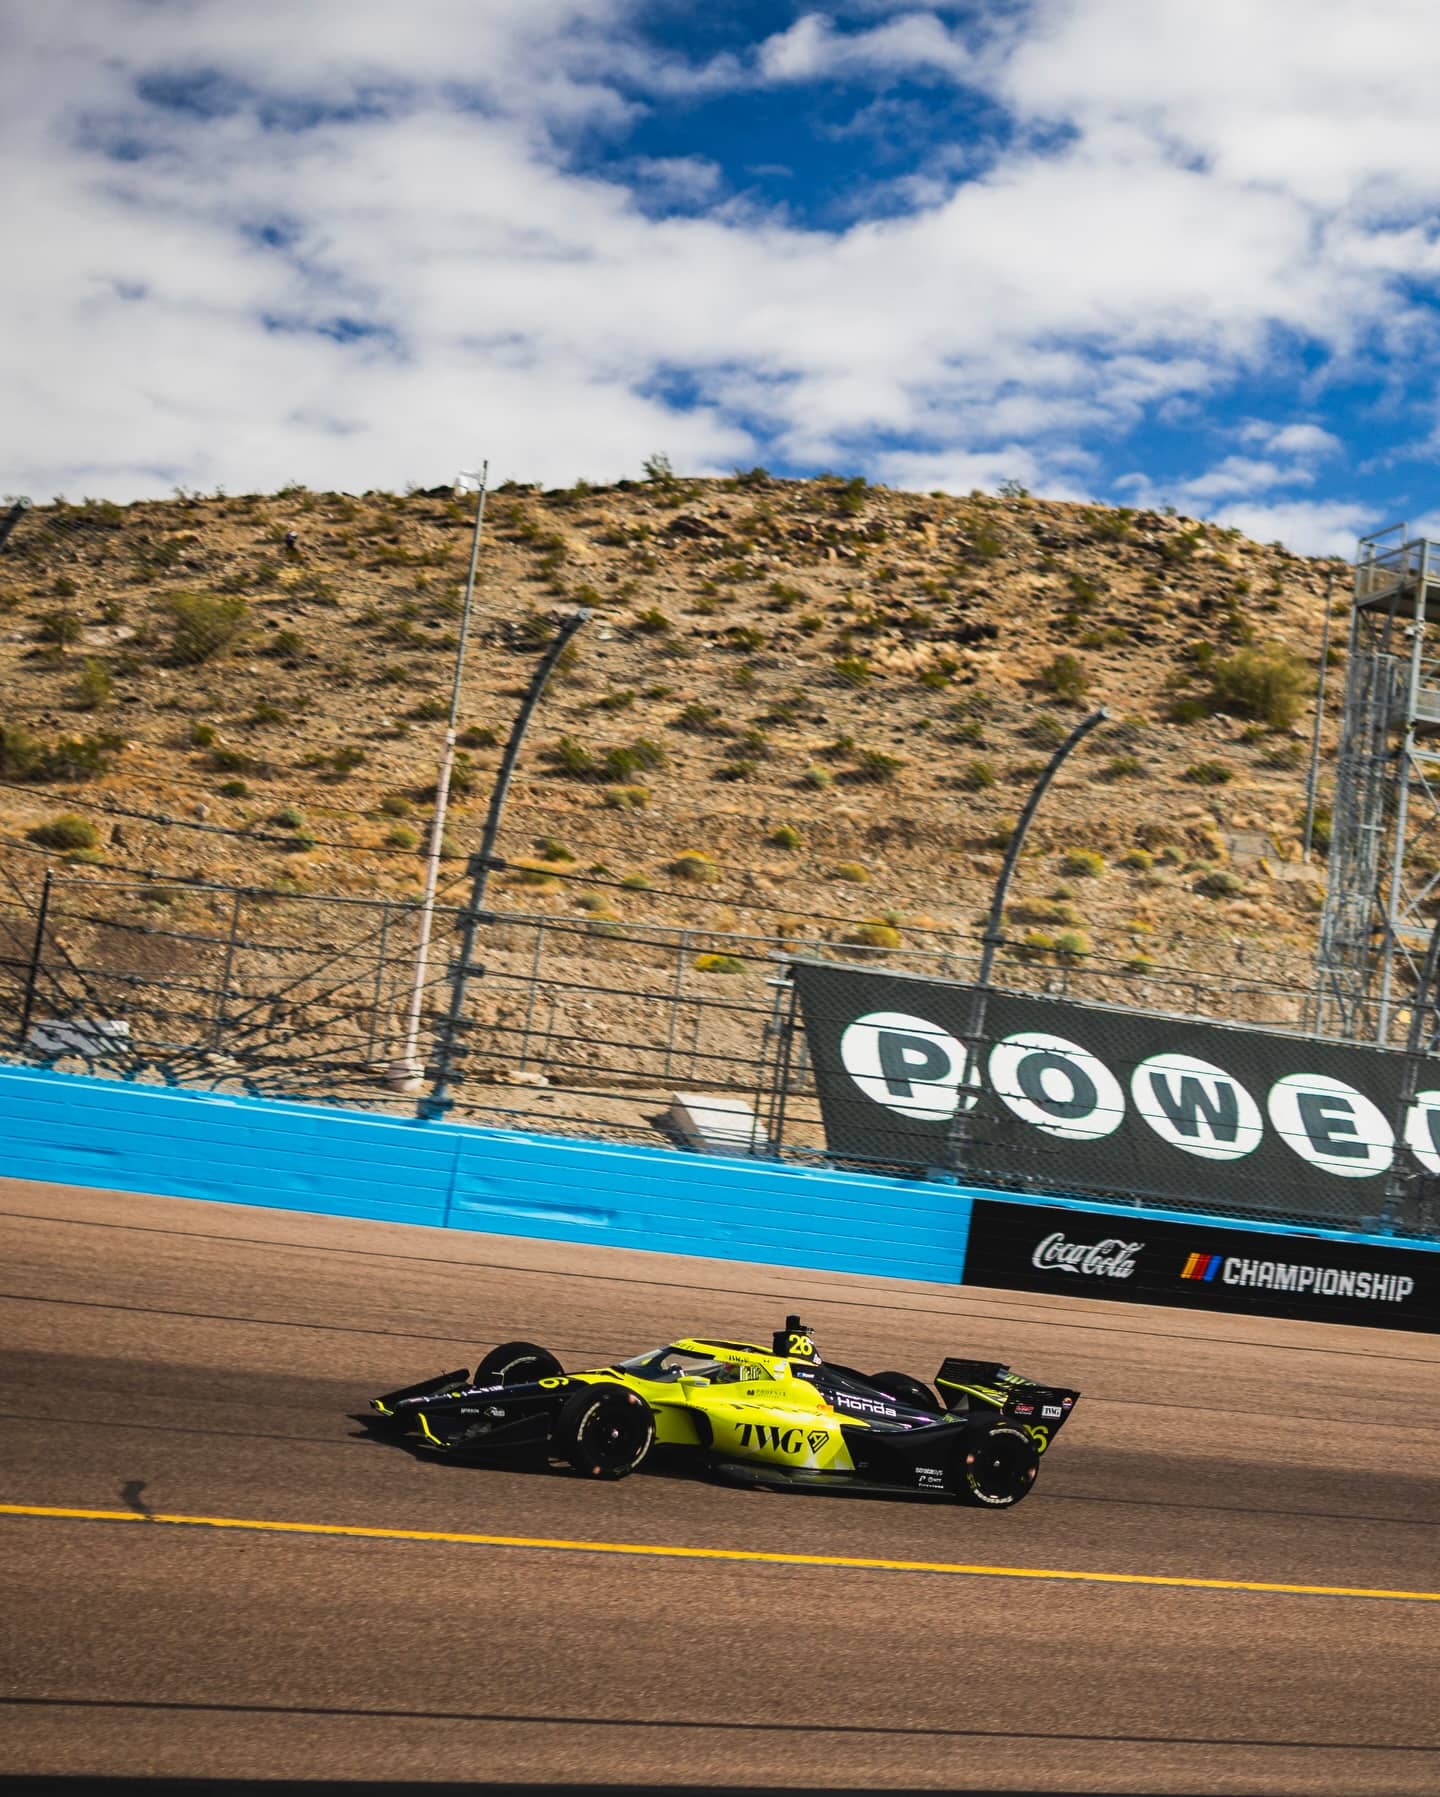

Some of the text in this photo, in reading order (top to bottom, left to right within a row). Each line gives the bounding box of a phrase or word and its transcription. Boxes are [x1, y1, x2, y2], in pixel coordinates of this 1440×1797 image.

[878, 1030, 1440, 1160] POWE
[1222, 1256, 1414, 1302] CHAMPIONSHIP
[788, 1334, 813, 1356] 26
[836, 1395, 897, 1417] Honda
[734, 1422, 804, 1454] TWG
